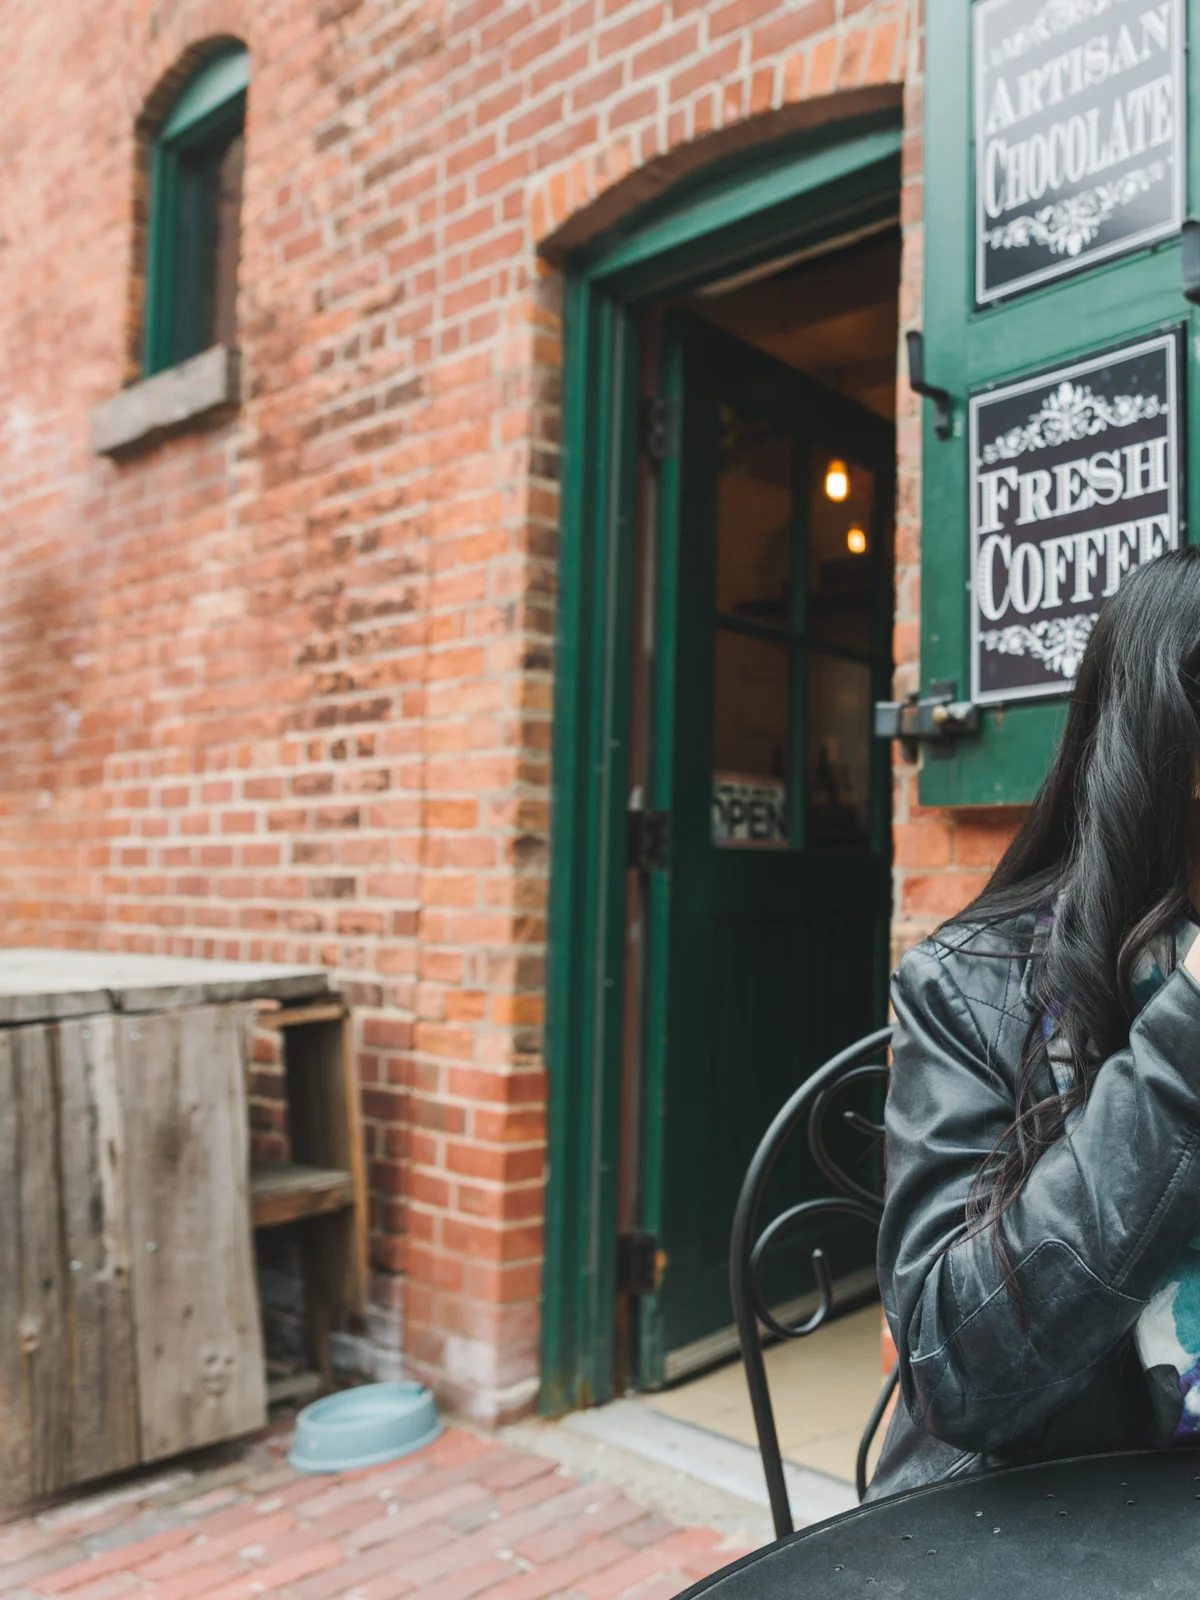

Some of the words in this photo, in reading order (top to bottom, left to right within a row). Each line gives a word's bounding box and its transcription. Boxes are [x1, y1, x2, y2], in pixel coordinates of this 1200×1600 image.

[985, 6, 1172, 135] ARTISAN
[984, 74, 1173, 218] CHOCOLATE
[977, 435, 1170, 535] FRESH
